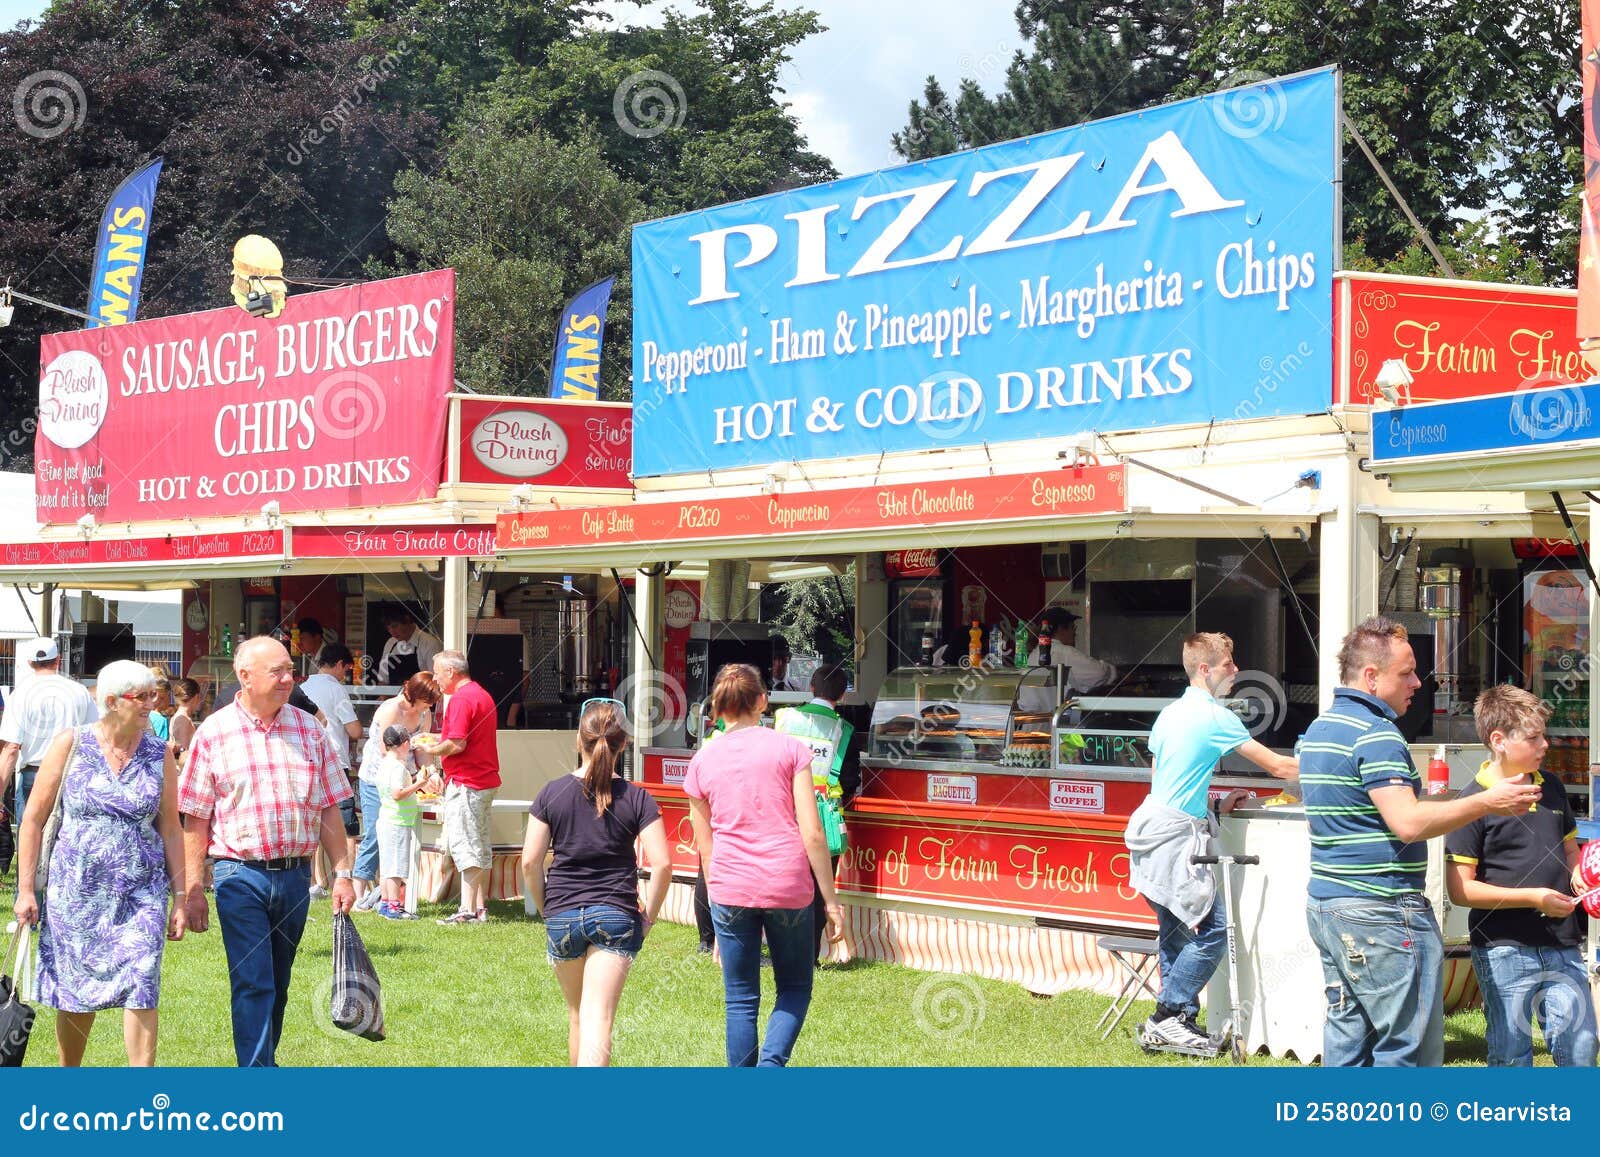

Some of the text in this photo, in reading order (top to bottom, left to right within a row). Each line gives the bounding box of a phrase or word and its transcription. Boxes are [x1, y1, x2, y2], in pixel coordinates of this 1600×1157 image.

[688, 130, 1245, 306] PIZZA
[642, 327, 748, 394] Pepperoni
[769, 317, 826, 364] Ham
[833, 310, 858, 355] &
[864, 284, 992, 359] Pineapple
[1018, 259, 1183, 339] Margherita
[1216, 238, 1315, 311] Chips
[120, 298, 442, 398] SAUSAGE, BURGERS
[1394, 319, 1592, 382] Farm Fres
[47, 366, 97, 396] Plush
[40, 397, 100, 426] Dining
[713, 348, 1193, 445] HOT & COLD DRINKS
[214, 394, 316, 458] CHIPS
[482, 420, 552, 441] Plush
[1389, 417, 1447, 452] Espresso
[476, 439, 559, 466] Dining
[38, 457, 103, 485] Fine fast food
[138, 456, 411, 503] HOT & COLD DRINKS
[35, 487, 58, 508] erved
[61, 491, 69, 508] at
[511, 477, 1095, 545] Espresso Cafe Latte PG2GO Cappuccino Hot Chocolate Espresso
[242, 533, 274, 552] PG2GO
[344, 530, 387, 552] Fair
[392, 530, 447, 552] Trade
[933, 785, 971, 799] BAGUETTE
[1054, 796, 1098, 806] COFFEE
[1057, 784, 1094, 794] FRESH
[885, 835, 909, 887] of
[918, 836, 999, 882] Farm
[1009, 844, 1098, 893] Fresh
